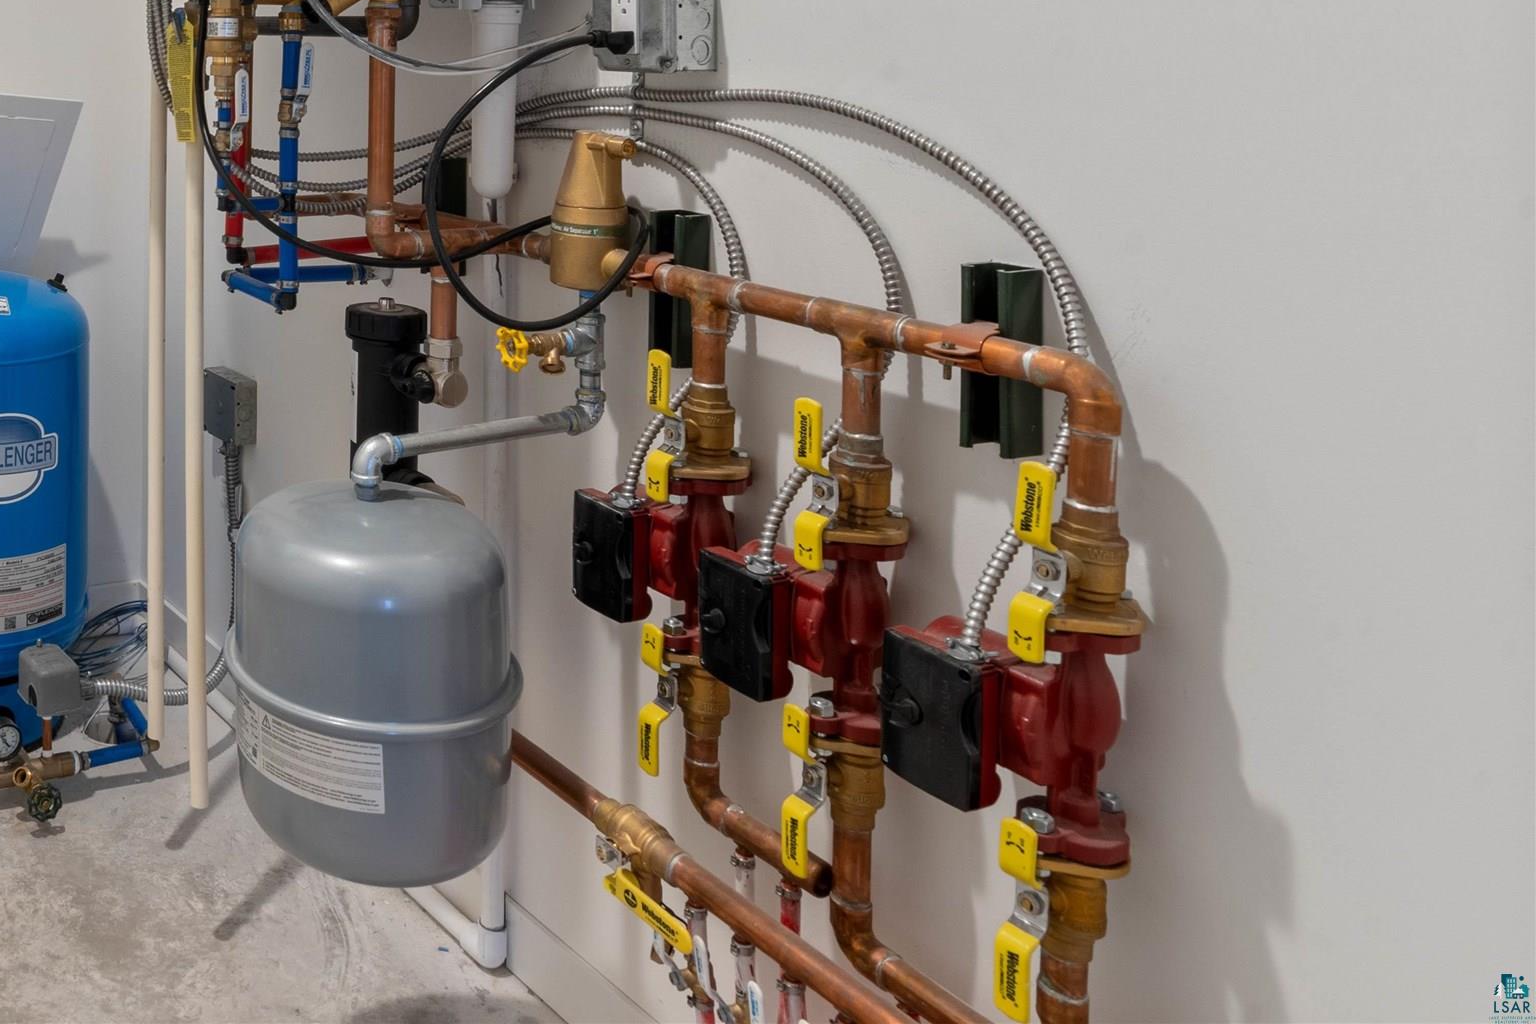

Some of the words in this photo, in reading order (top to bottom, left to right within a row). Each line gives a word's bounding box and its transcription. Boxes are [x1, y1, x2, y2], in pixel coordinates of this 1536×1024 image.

[650, 366, 658, 405] Webstone
[798, 415, 807, 458] Webstone
[1020, 482, 1036, 532] Webstone
[1007, 950, 1019, 1002] Webstone
